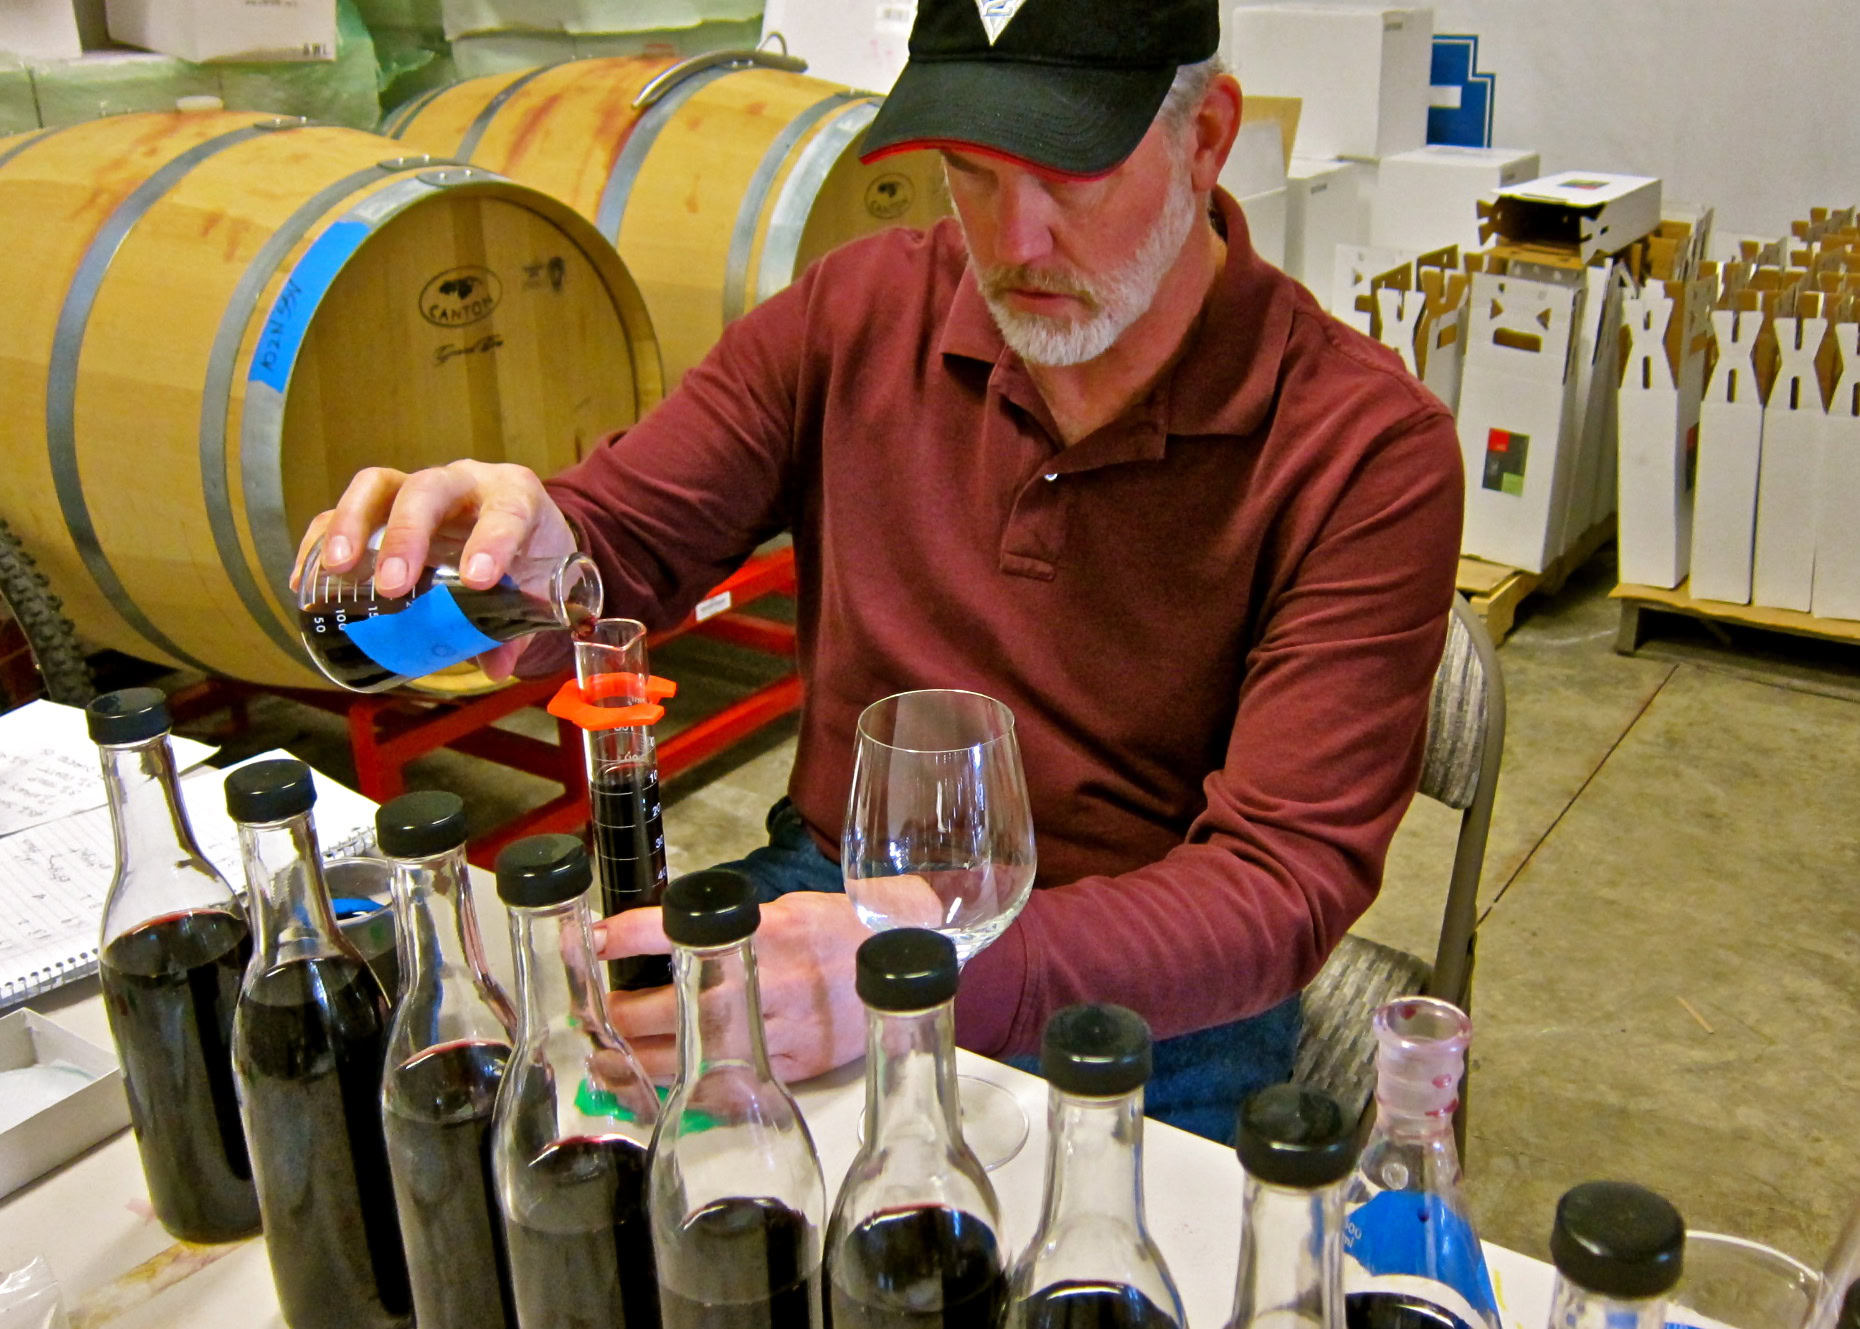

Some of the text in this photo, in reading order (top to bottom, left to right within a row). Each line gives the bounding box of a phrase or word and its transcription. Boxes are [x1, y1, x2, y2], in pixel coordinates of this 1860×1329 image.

[429, 298, 493, 321] CANTON
[313, 616, 326, 633] 50
[652, 801, 661, 817] 20
